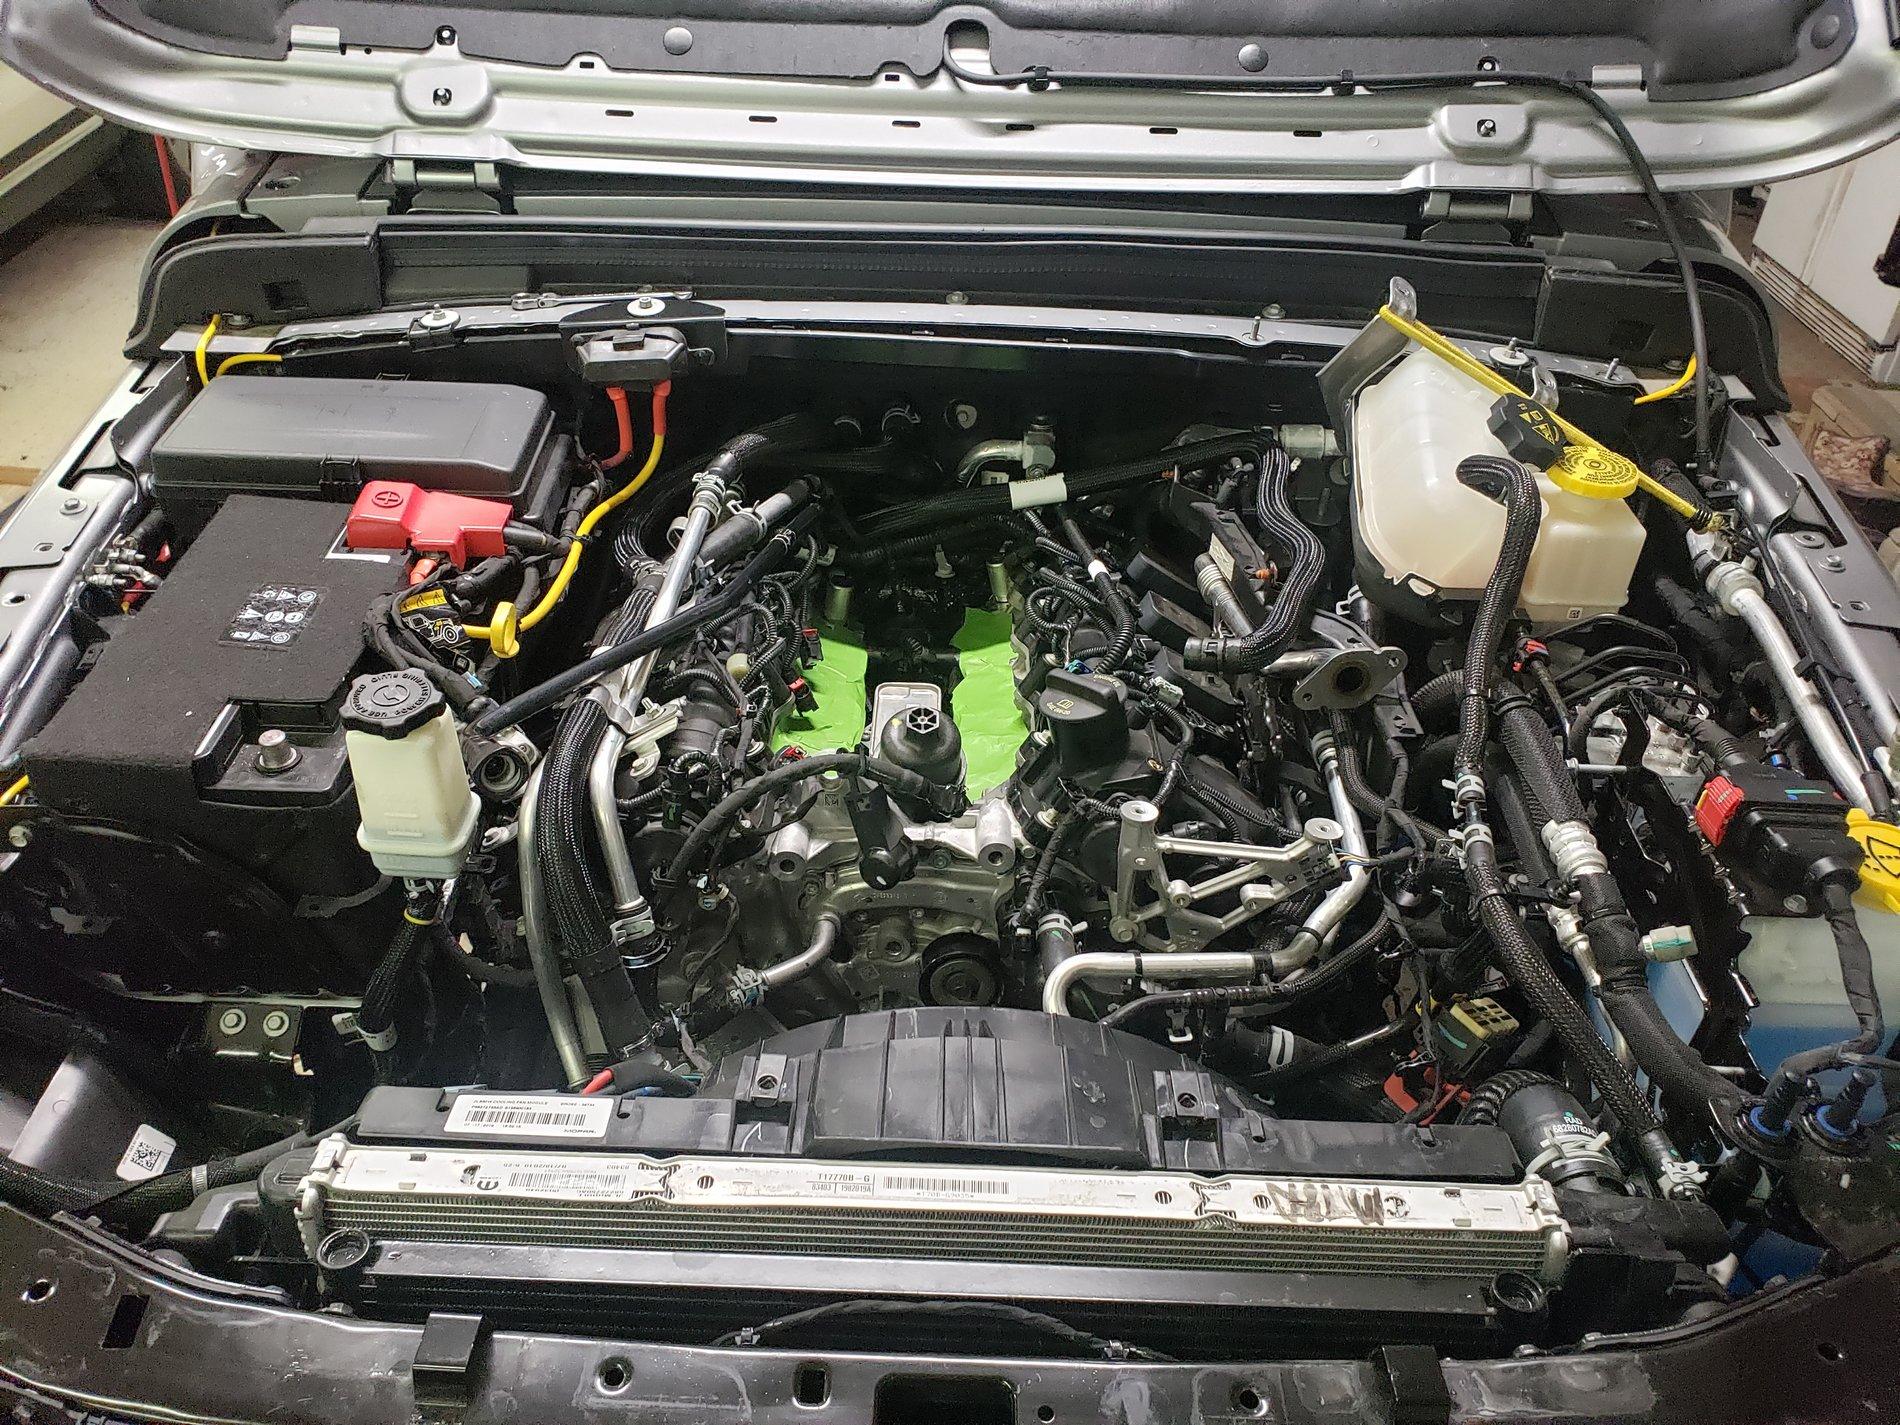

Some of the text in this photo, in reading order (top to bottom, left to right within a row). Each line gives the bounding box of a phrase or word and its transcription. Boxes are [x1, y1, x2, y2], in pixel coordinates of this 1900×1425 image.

[371, 673, 399, 683] FLUID
[402, 673, 428, 696] STEERING
[353, 684, 367, 713] APPROVED
[1563, 1116, 1583, 1125] RAD
